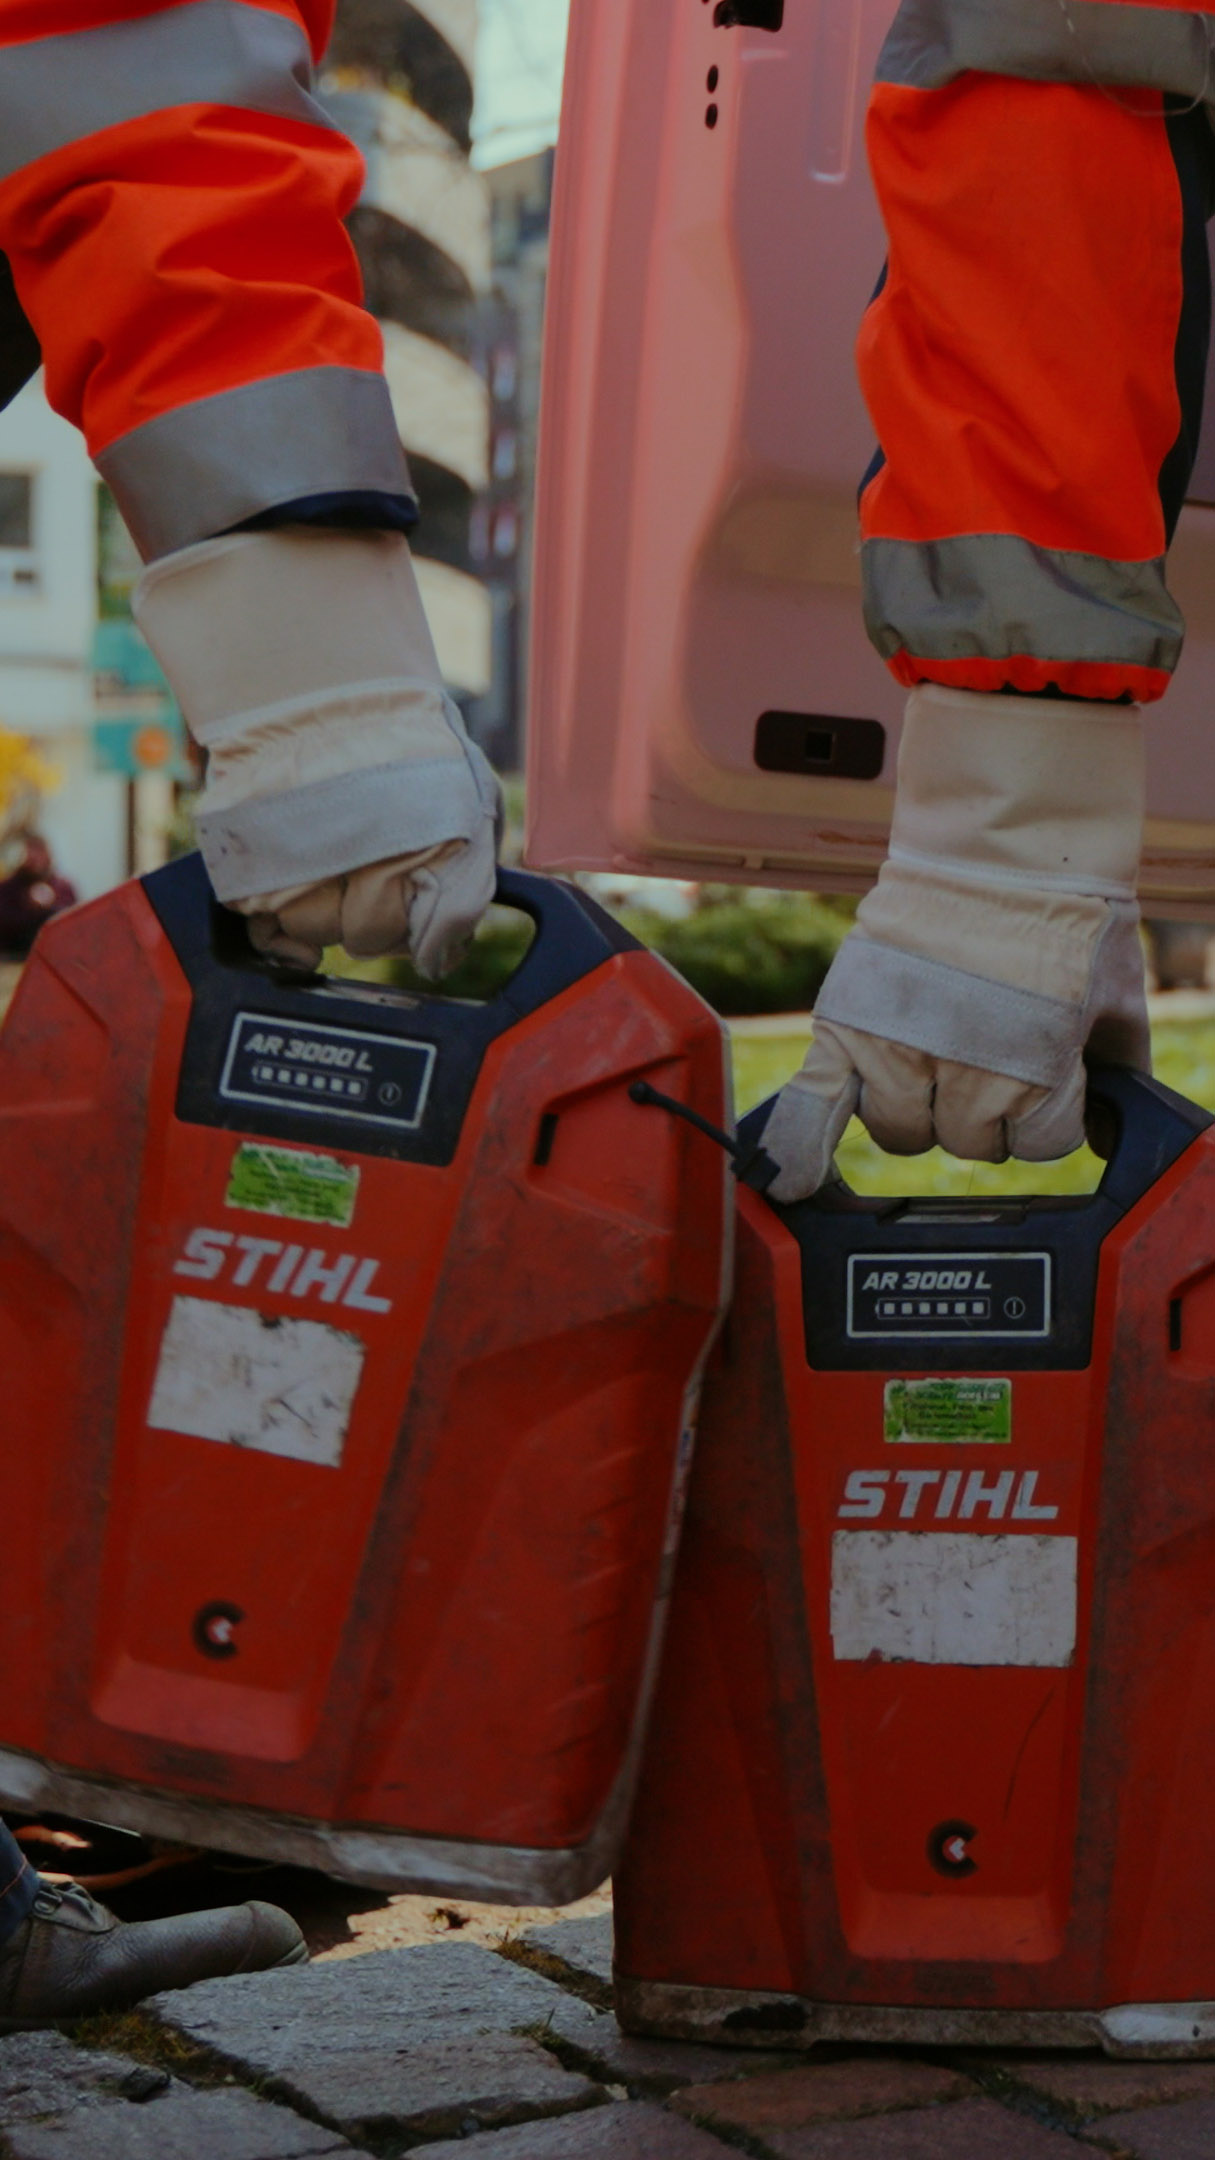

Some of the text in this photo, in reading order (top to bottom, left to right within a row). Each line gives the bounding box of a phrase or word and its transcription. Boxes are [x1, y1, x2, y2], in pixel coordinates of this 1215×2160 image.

[244, 1033, 373, 1072] AR 3000 L
[172, 1226, 393, 1314] STIHL
[861, 1271, 992, 1291] AR 3000 L
[837, 1469, 1060, 1520] STIHL
